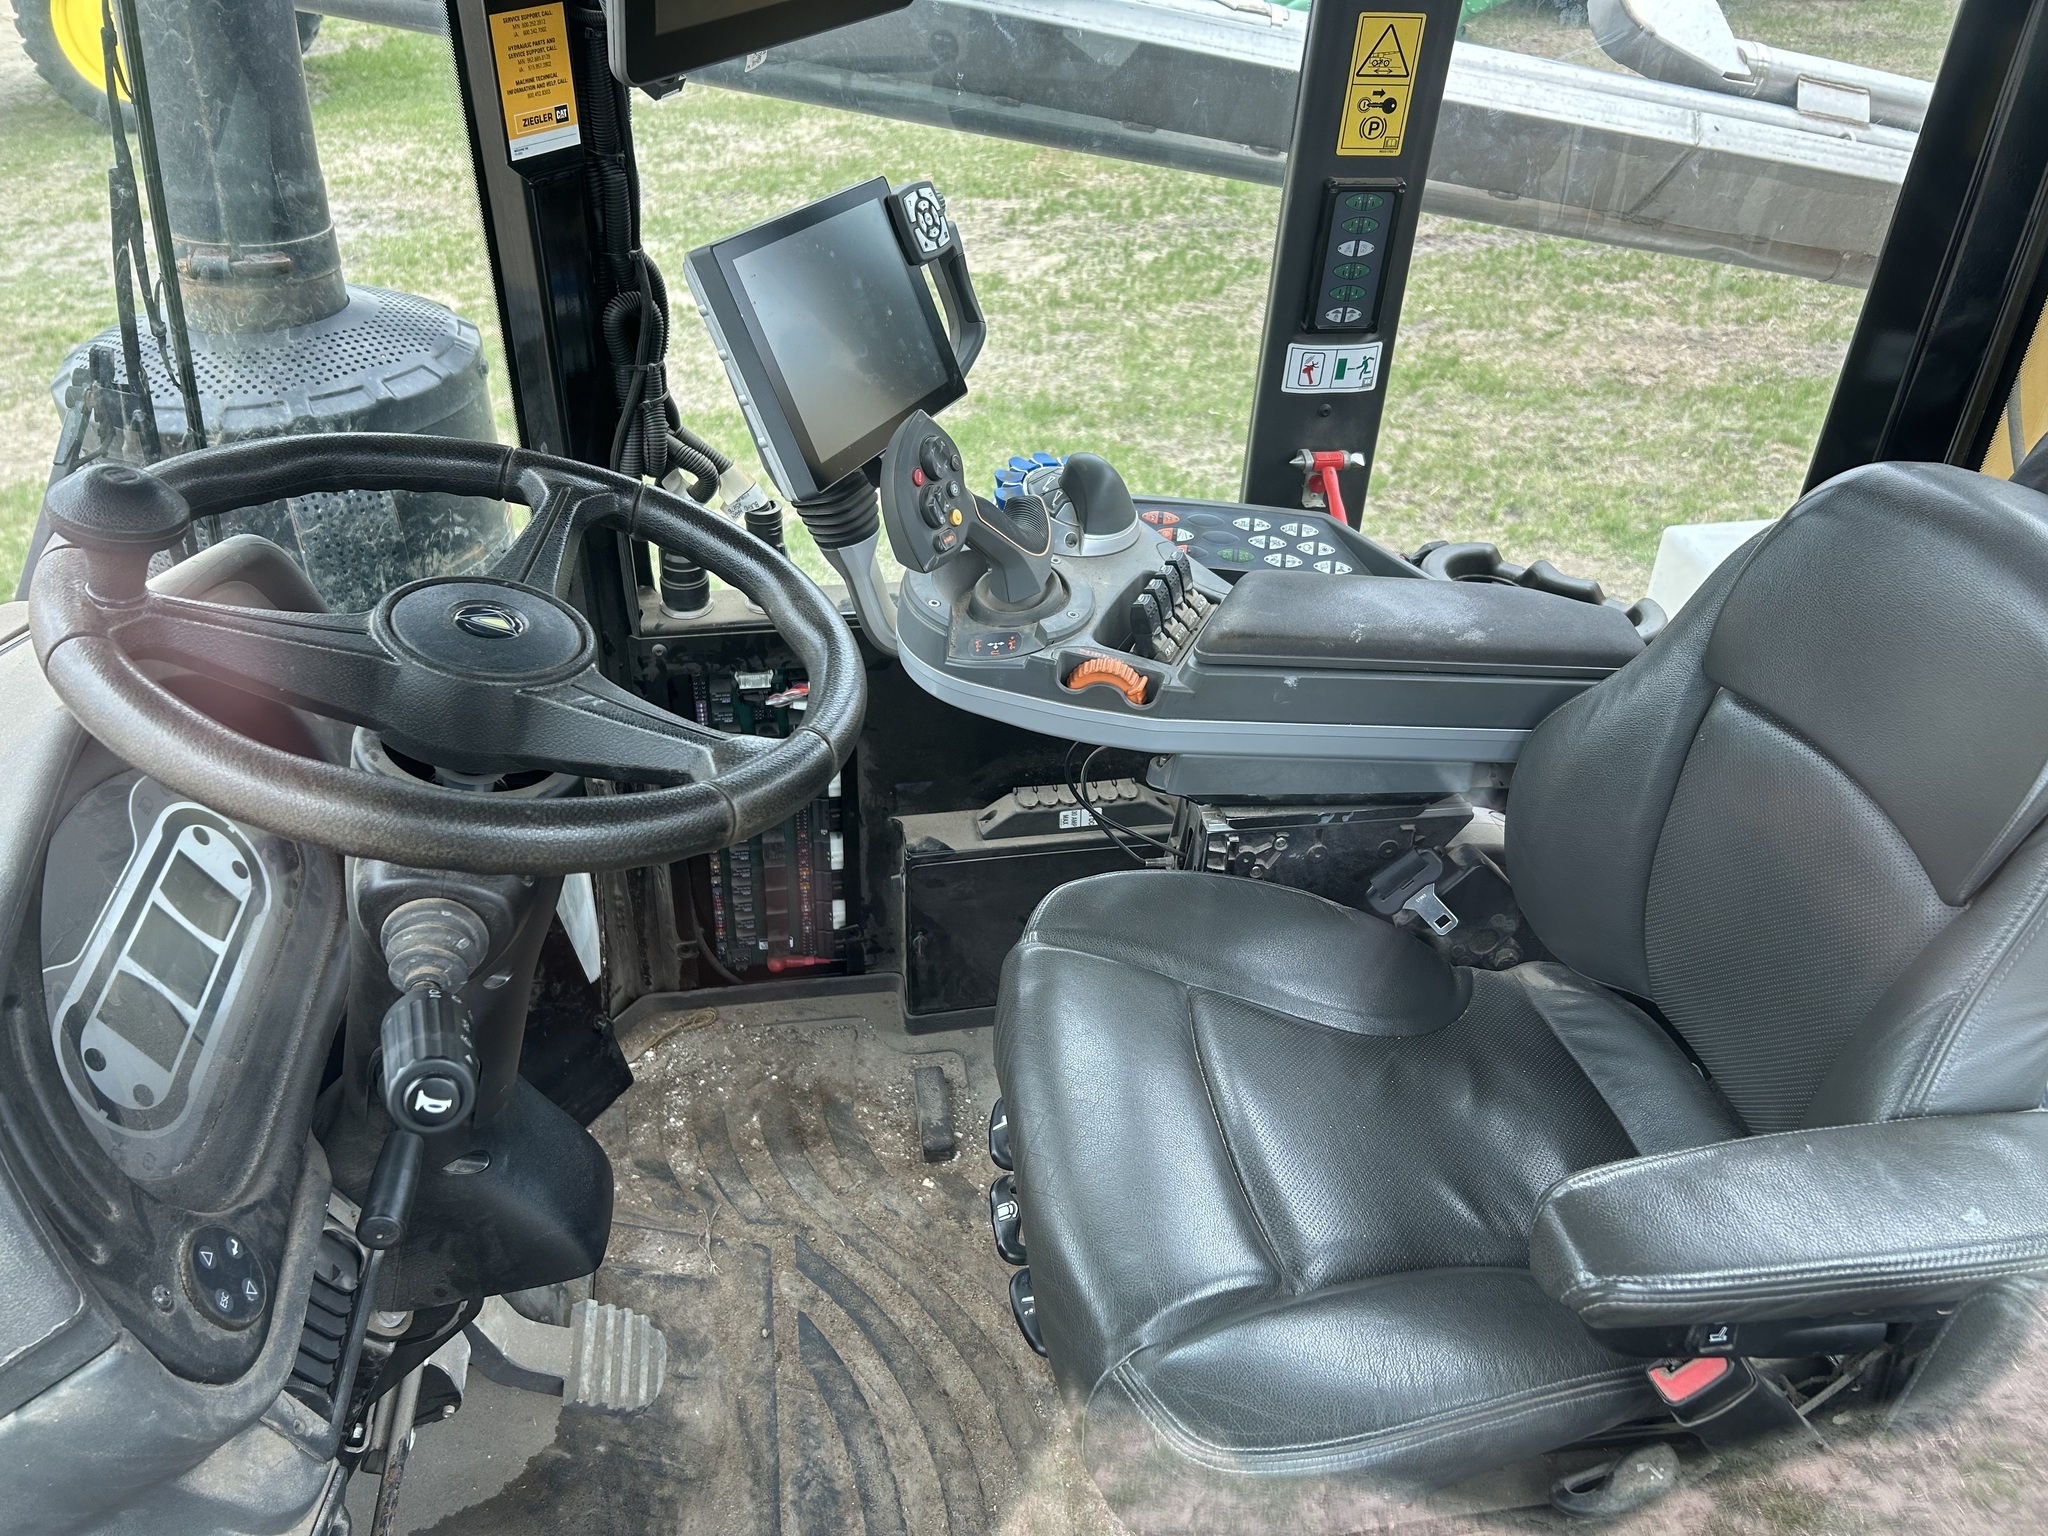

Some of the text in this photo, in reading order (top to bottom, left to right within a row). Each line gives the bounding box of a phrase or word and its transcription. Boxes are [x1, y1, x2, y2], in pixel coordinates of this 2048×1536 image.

[502, 16, 520, 24] SERVICE
[508, 42, 532, 51] HYDRAULIC
[508, 51, 526, 59] SERVICE
[515, 72, 558, 86] MACHINE TECHNICAL
[506, 85, 536, 95] INFORMATION
[522, 112, 554, 127] ZIEGLER
[556, 108, 568, 120] CAT
[1367, 120, 1380, 136] P
[1062, 814, 1070, 826] MAX
[219, 1291, 230, 1309] ESC
